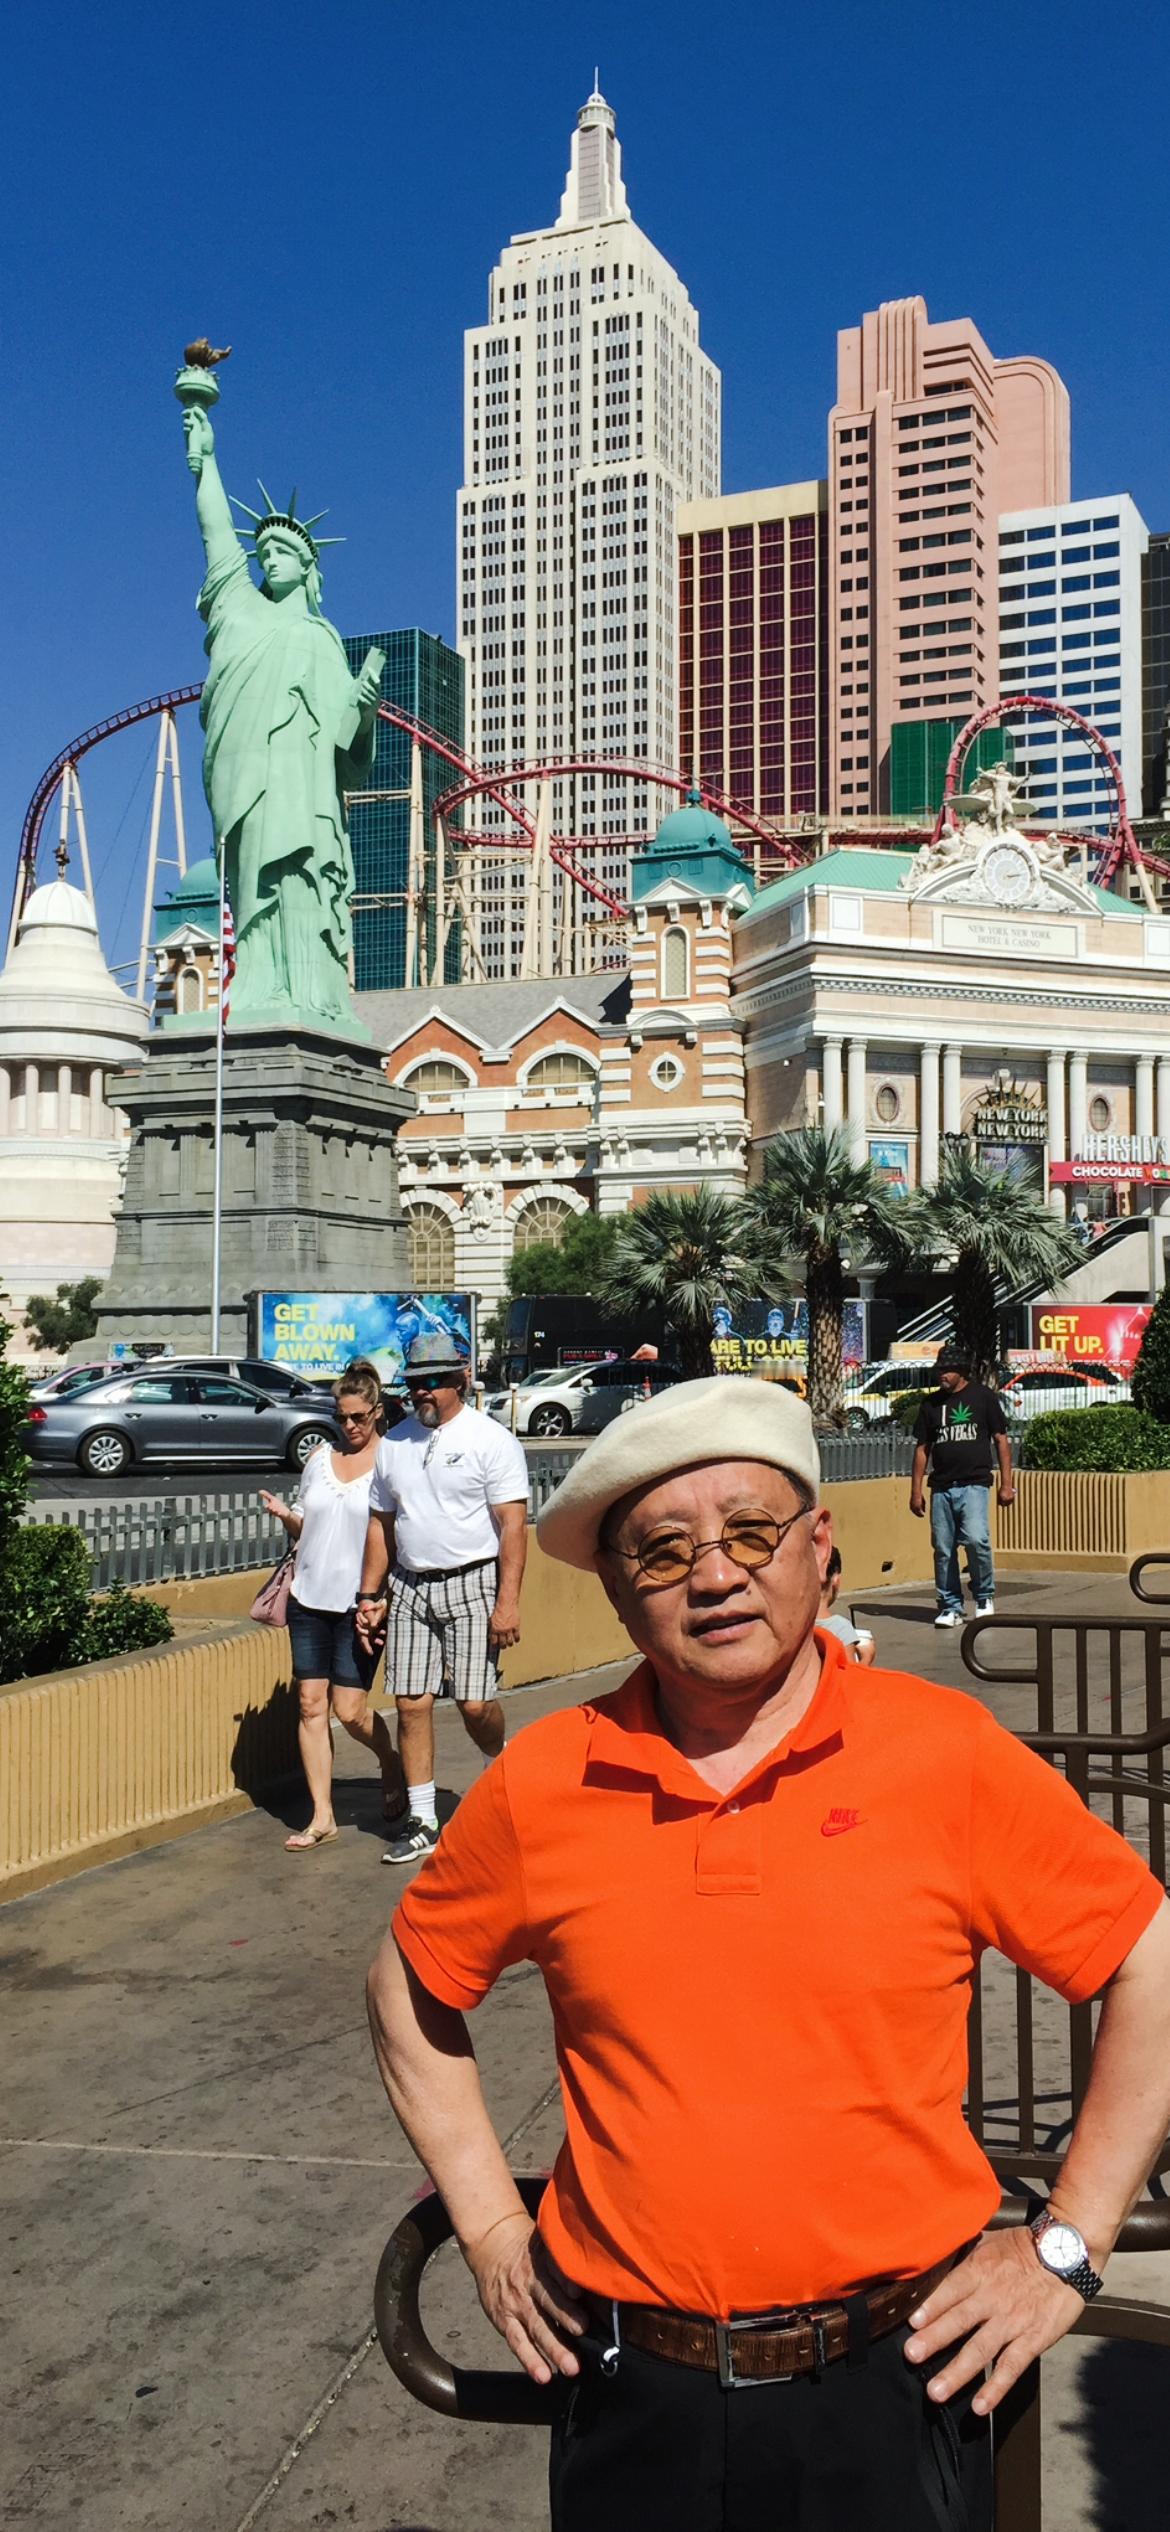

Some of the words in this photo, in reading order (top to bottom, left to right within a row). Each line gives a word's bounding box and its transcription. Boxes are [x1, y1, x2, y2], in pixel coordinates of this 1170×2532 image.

[968, 924, 985, 934] NEW
[987, 926, 1009, 936] YORK
[1011, 928, 1029, 937] NEW
[1031, 930, 1052, 940] YORK
[977, 936, 1001, 945] HOTEL
[1012, 938, 1041, 948] CASINO
[977, 1107, 1009, 1120] NEW
[1013, 1108, 1048, 1122] YORK
[977, 1121, 1009, 1136] NEW
[1013, 1122, 1048, 1138] YORK
[1082, 1134, 1168, 1163] HERSHEY'S
[1072, 1166, 1143, 1178] CHOCOLATE
[274, 1303, 319, 1321] GET
[274, 1323, 355, 1341] BLOWN
[1039, 1315, 1079, 1333] GET
[274, 1343, 340, 1361] AWAY.
[746, 1339, 768, 1354] TO
[770, 1339, 807, 1354] LIVE
[1040, 1336, 1069, 1353] LIT
[1074, 1336, 1104, 1354] UP.
[941, 1404, 947, 1426] I
[950, 1423, 978, 1441] VEGAS
[828, 1808, 859, 1824] NIKE
